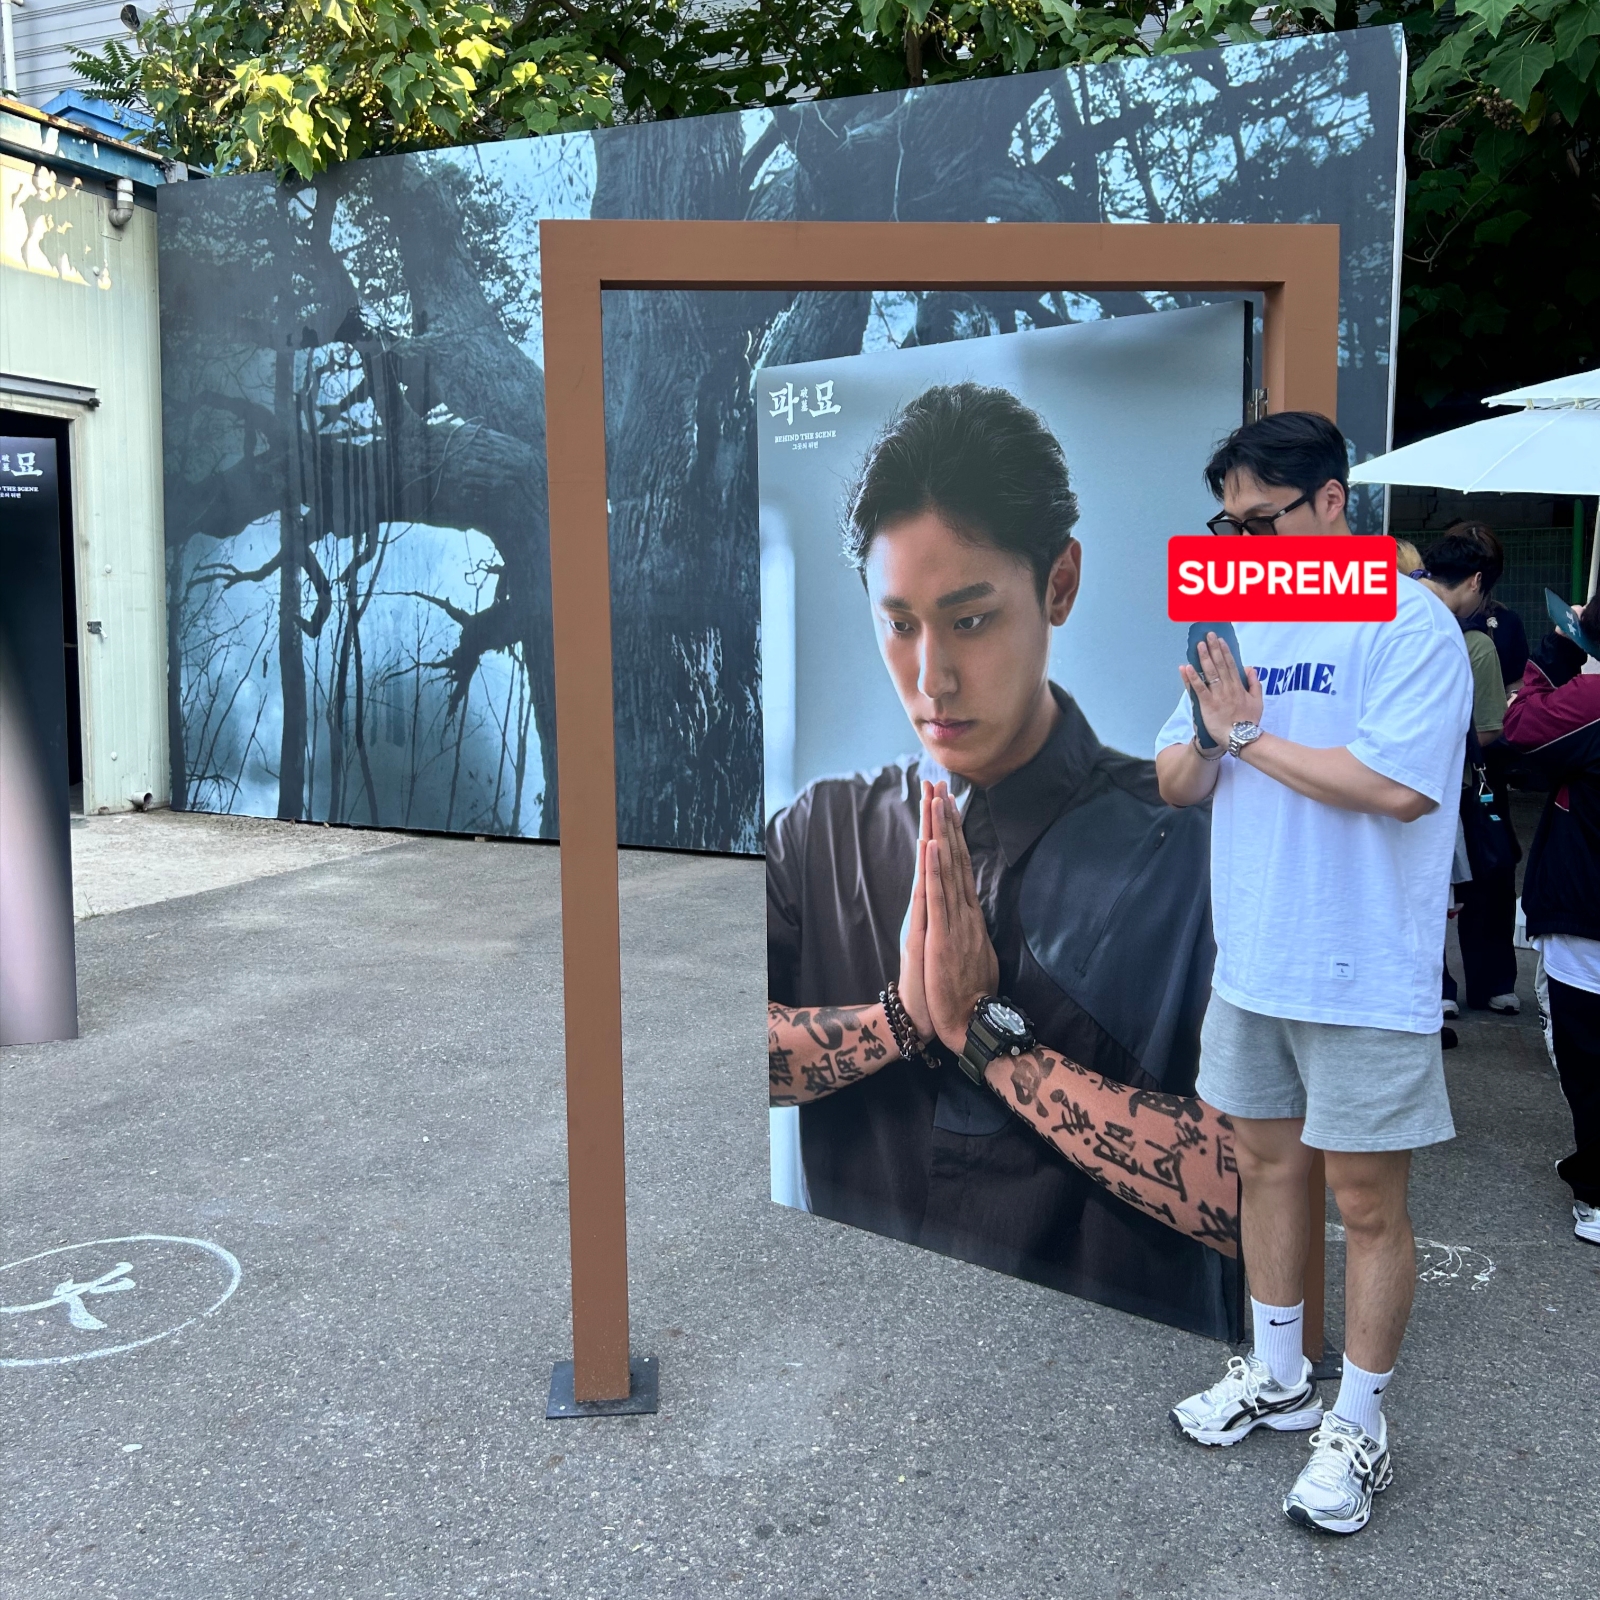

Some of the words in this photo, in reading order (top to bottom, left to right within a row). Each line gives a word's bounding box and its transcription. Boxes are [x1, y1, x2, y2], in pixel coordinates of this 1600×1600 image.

[775, 434, 800, 443] BEHIND
[815, 430, 836, 439] SCENE
[10, 452, 43, 477] 묘
